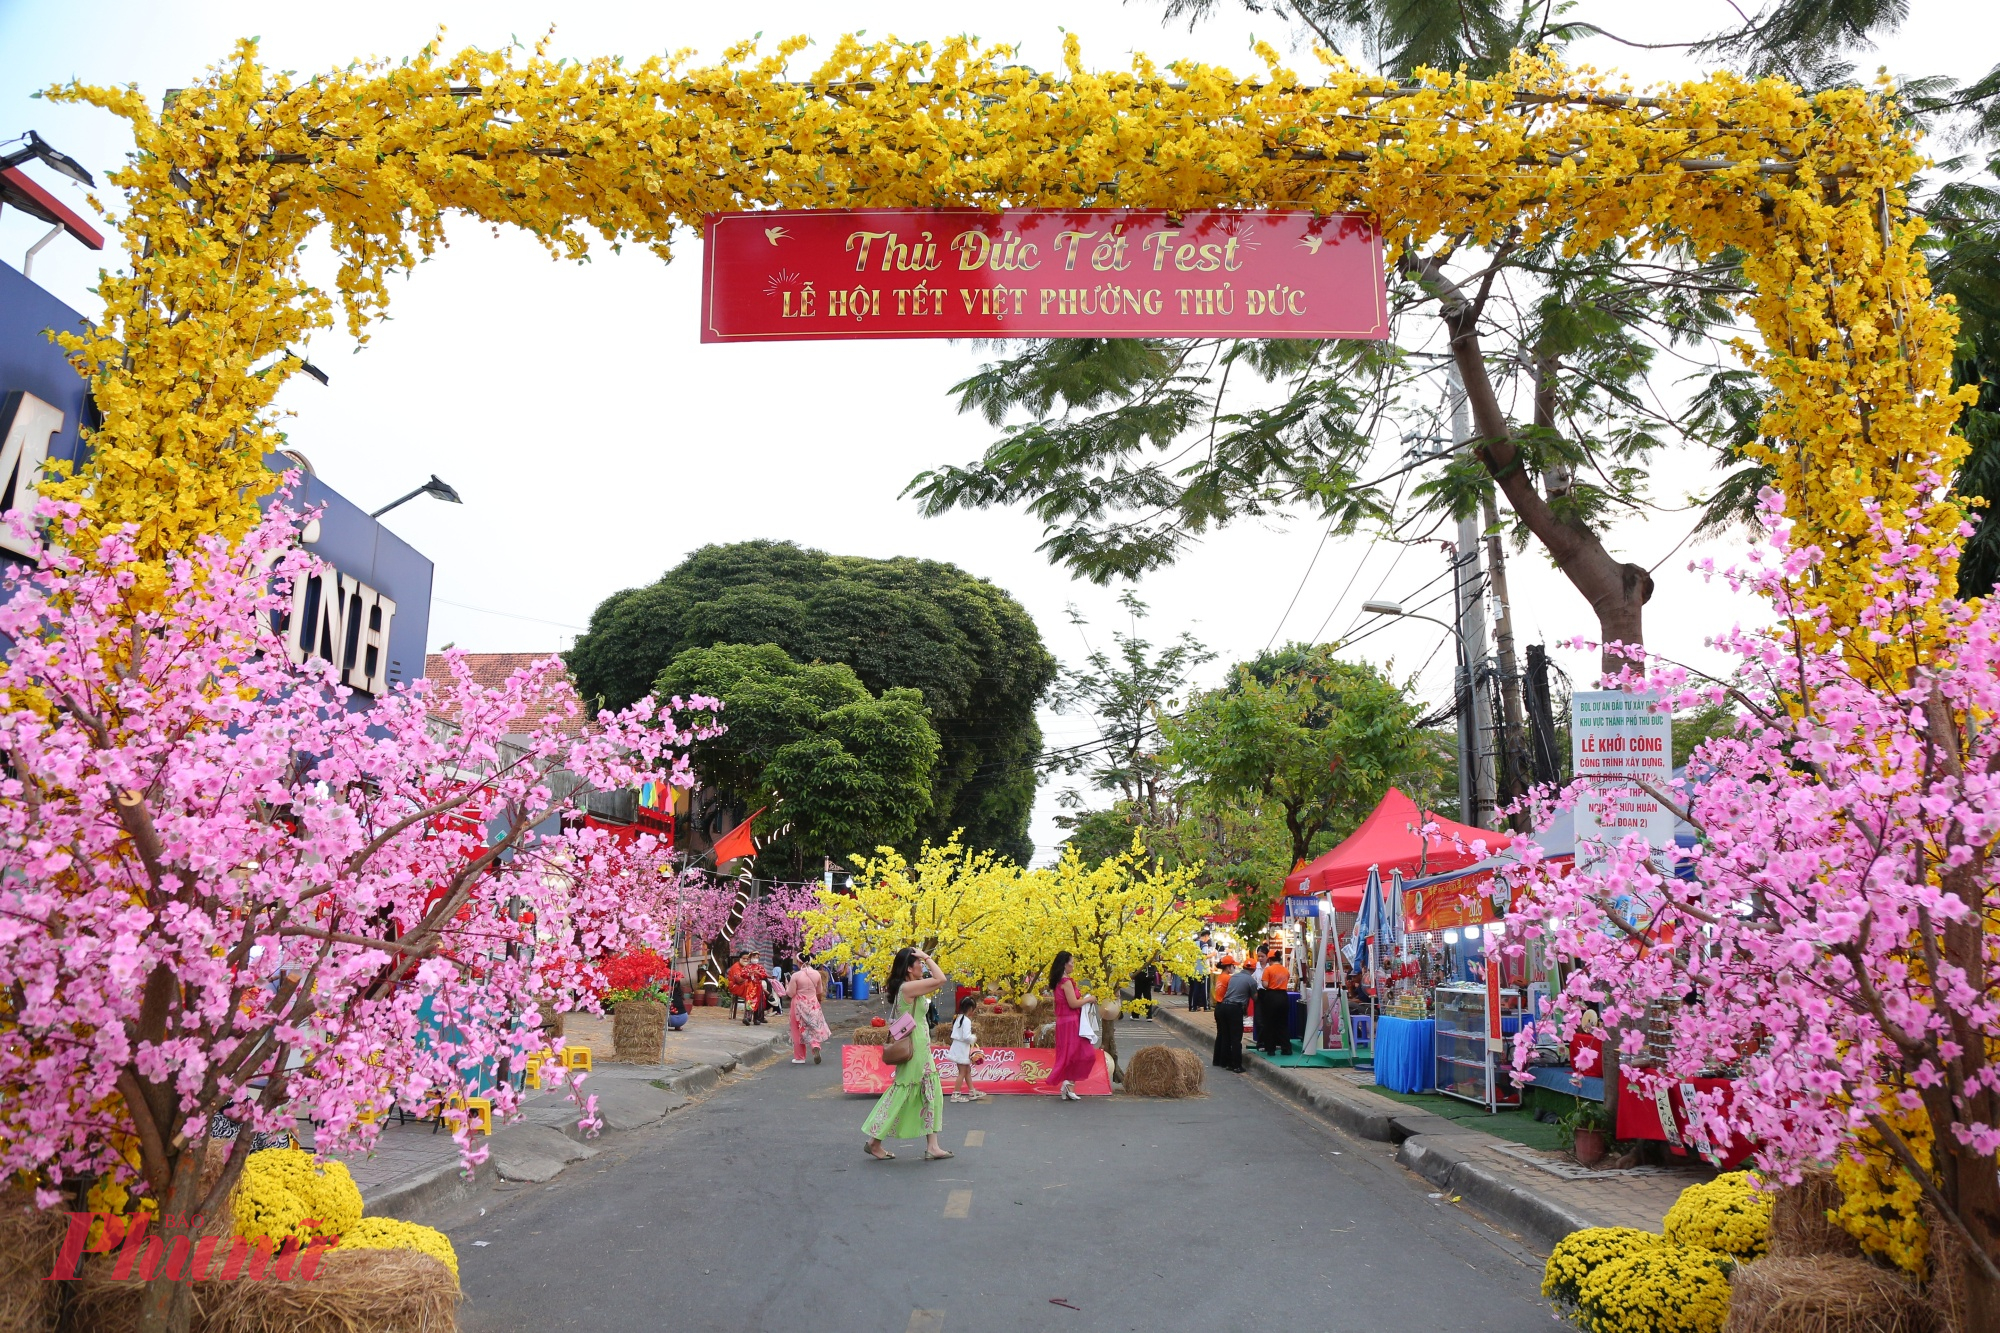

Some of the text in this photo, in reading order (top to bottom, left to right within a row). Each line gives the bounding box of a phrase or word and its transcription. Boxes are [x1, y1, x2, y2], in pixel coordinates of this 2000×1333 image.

[846, 224, 1243, 271] Thủ Đức Tết Fest
[782, 279, 1307, 322] LỄ HỘI TẾT VIỆT PHƯỜNG THỦ ĐỨC
[1580, 713, 1664, 728] KHU VỰC THÀNH PHỐ THỦ ĐỨC
[1582, 733, 1662, 752] LỄ KHỞI CÔNG
[1580, 757, 1600, 768] CÔNG
[1602, 756, 1624, 767] TRÌNH
[1625, 756, 1640, 767] XÂY
[1636, 802, 1658, 813] HUÂN
[1617, 817, 1638, 829] ĐOẠN
[1639, 818, 1648, 828] 2)
